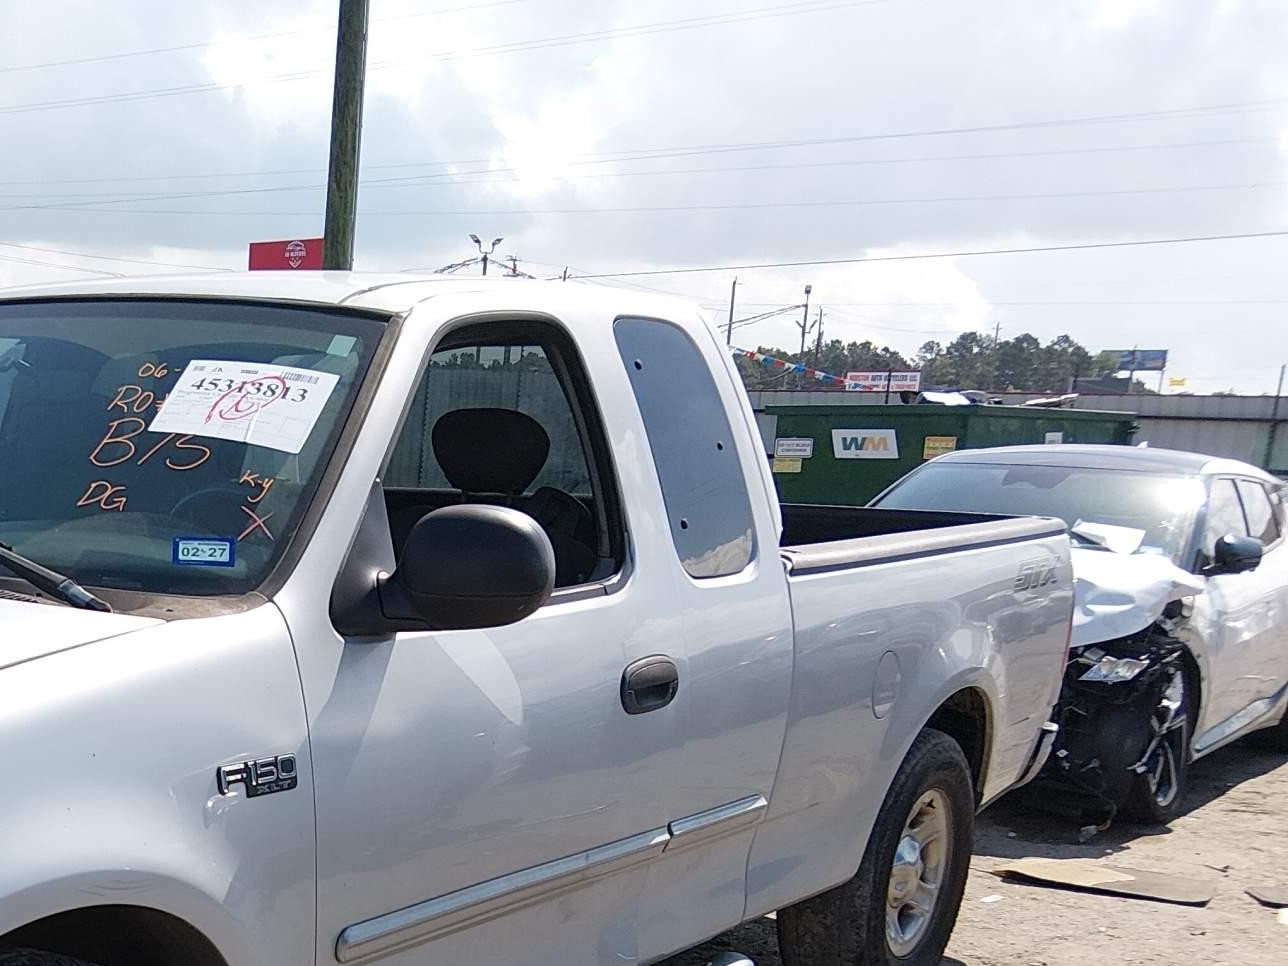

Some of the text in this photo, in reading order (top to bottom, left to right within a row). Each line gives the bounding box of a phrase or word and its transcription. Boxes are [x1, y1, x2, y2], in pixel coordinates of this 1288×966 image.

[192, 376, 309, 403] 45313813
[841, 436, 889, 451] WM
[76, 480, 128, 512] DG
[181, 546, 227, 558] 02 27
[257, 780, 292, 794] XLT
